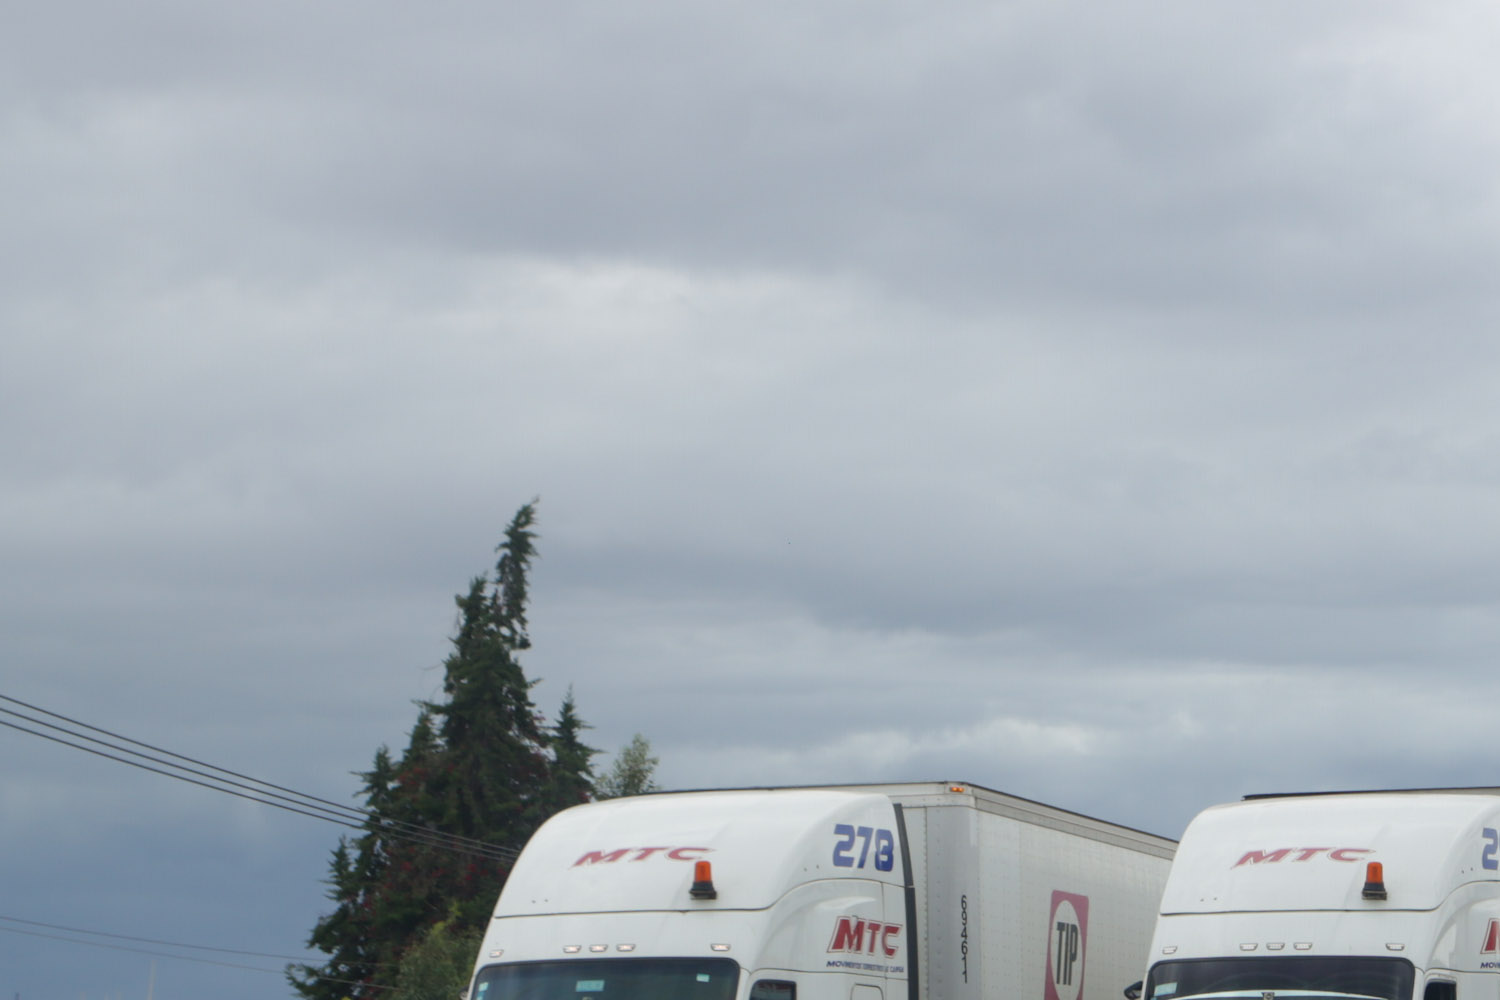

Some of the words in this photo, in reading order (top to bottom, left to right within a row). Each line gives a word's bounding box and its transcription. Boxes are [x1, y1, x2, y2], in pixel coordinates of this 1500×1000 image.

[569, 846, 716, 870] MTC
[833, 824, 894, 872] 278
[1230, 847, 1376, 870] MTC
[827, 915, 903, 959] MTC
[1056, 921, 1078, 986] TIP
